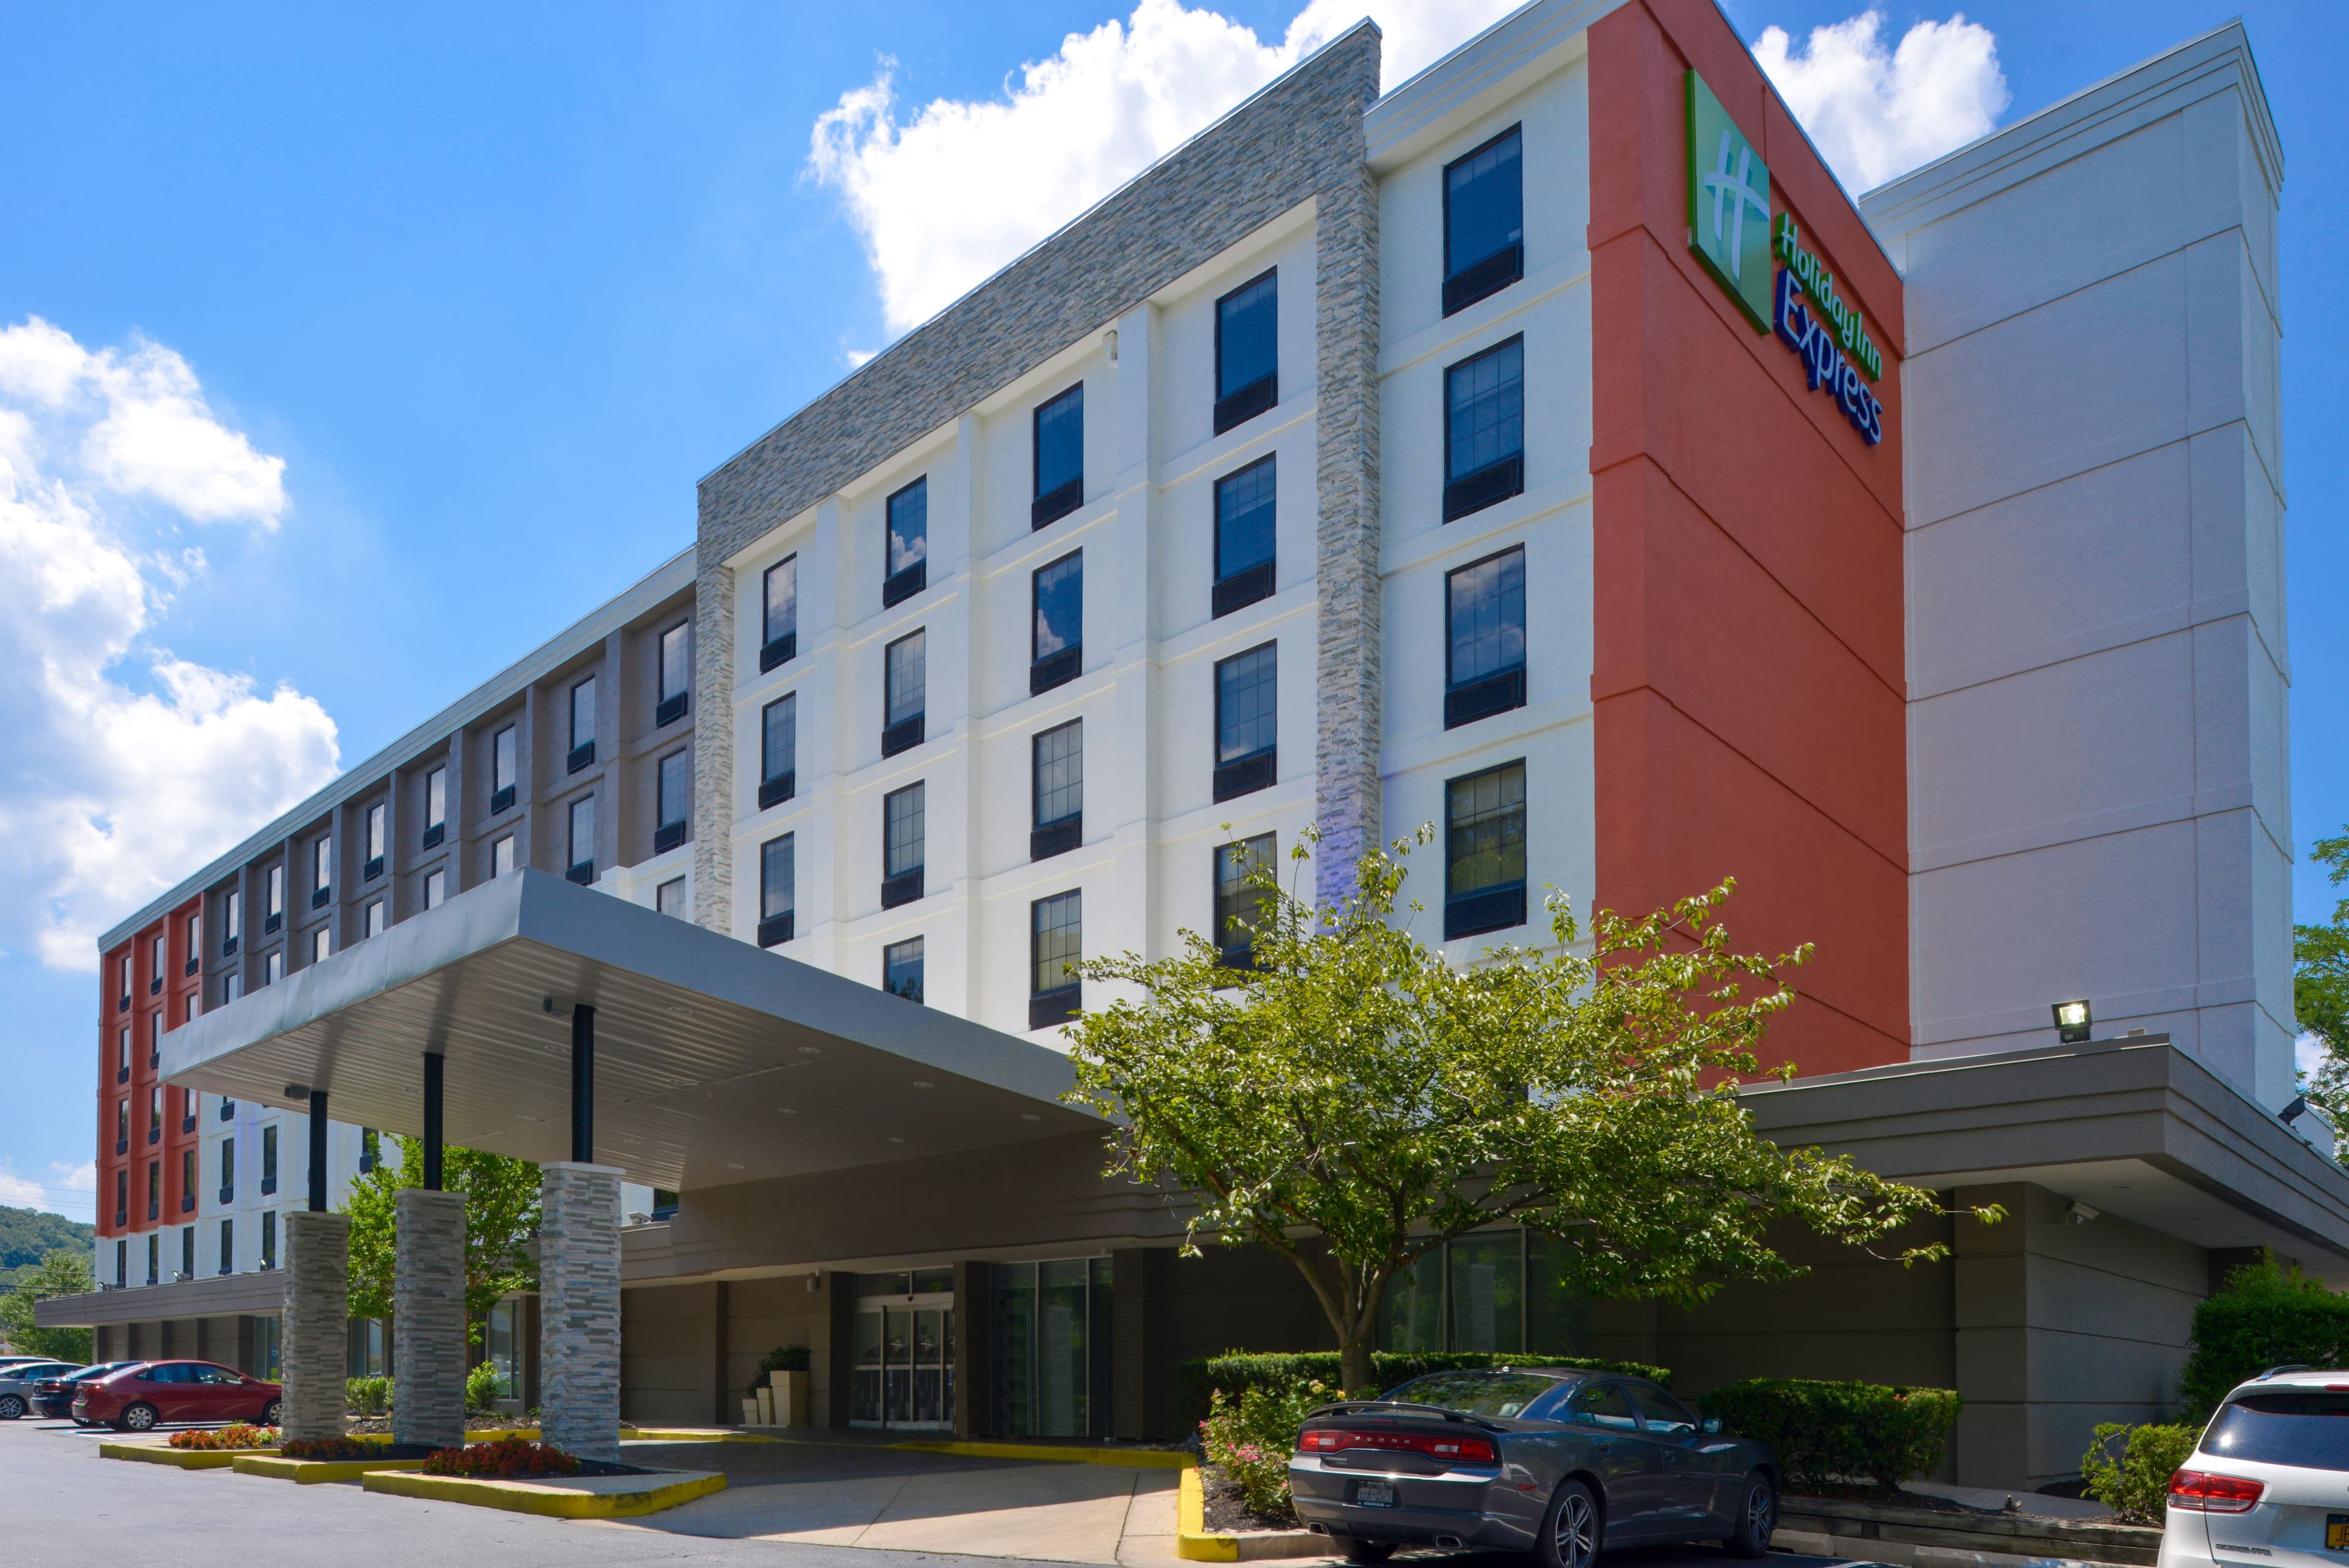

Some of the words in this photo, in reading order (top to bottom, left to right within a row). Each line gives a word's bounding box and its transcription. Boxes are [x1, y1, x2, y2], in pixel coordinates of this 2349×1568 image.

[1782, 212, 1854, 349] Holiday
[1857, 311, 1882, 381] Inn
[1783, 269, 1882, 444] Express
